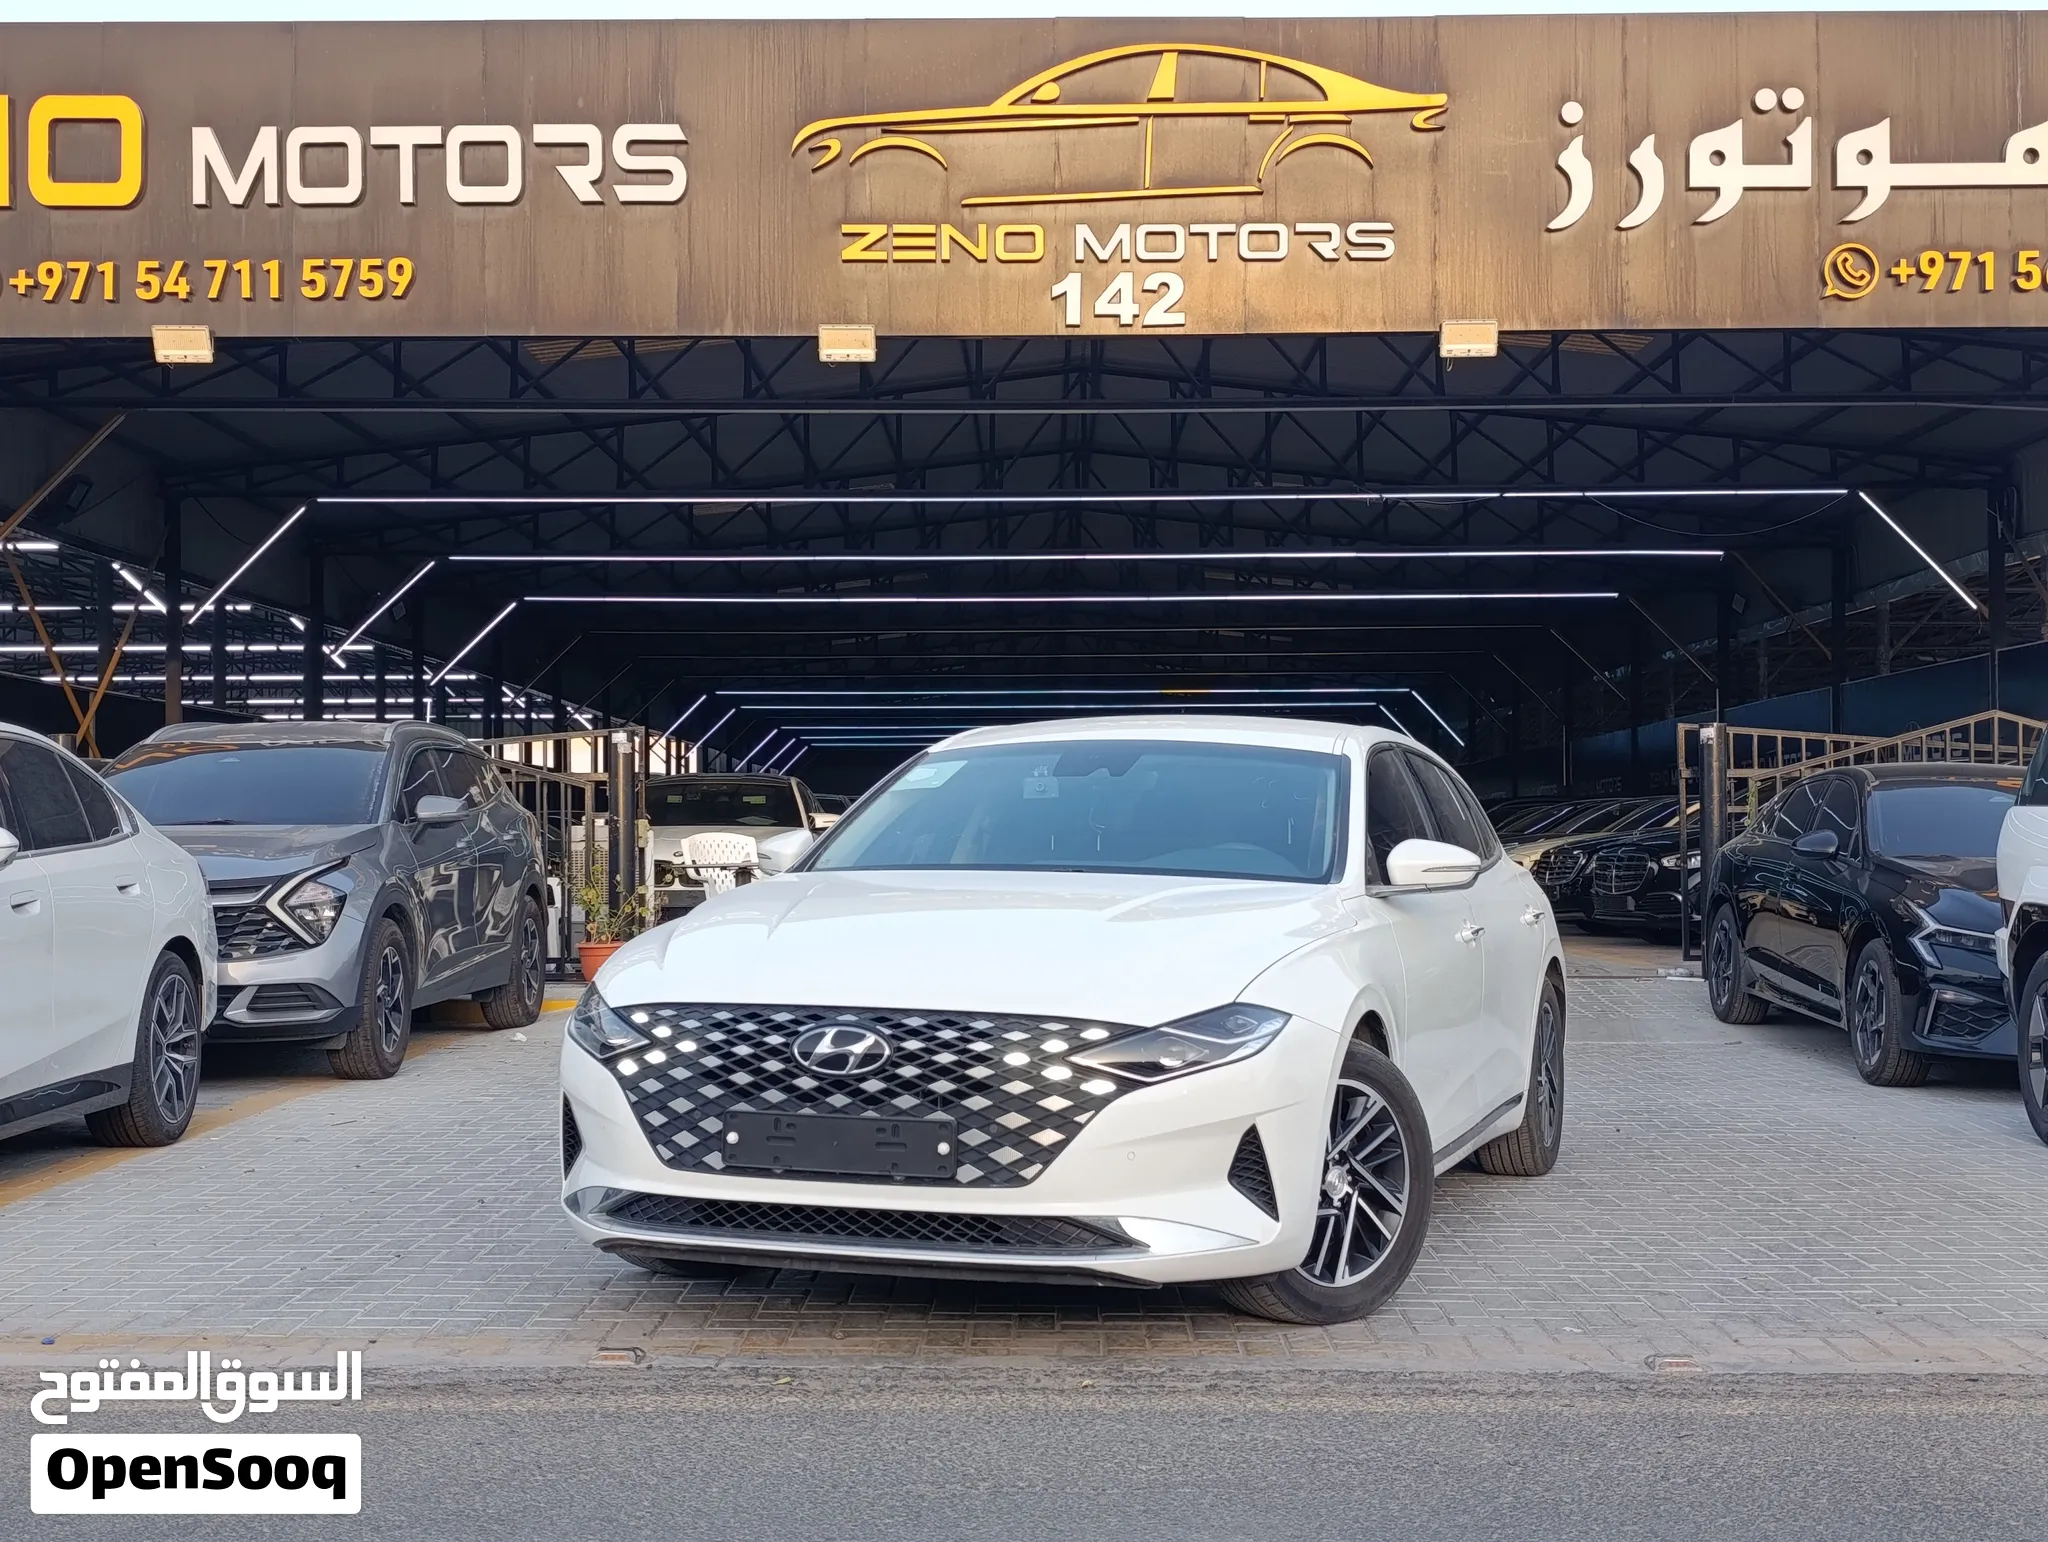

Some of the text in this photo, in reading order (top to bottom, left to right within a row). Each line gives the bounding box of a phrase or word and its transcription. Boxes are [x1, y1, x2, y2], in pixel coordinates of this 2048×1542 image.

[192, 123, 687, 205] MOTORS
[842, 222, 1396, 260] ZENO MOTORS
[10, 257, 413, 300] +971 54 711 5759
[1891, 250, 2048, 291] +971 5
[1051, 272, 1186, 326] 142
